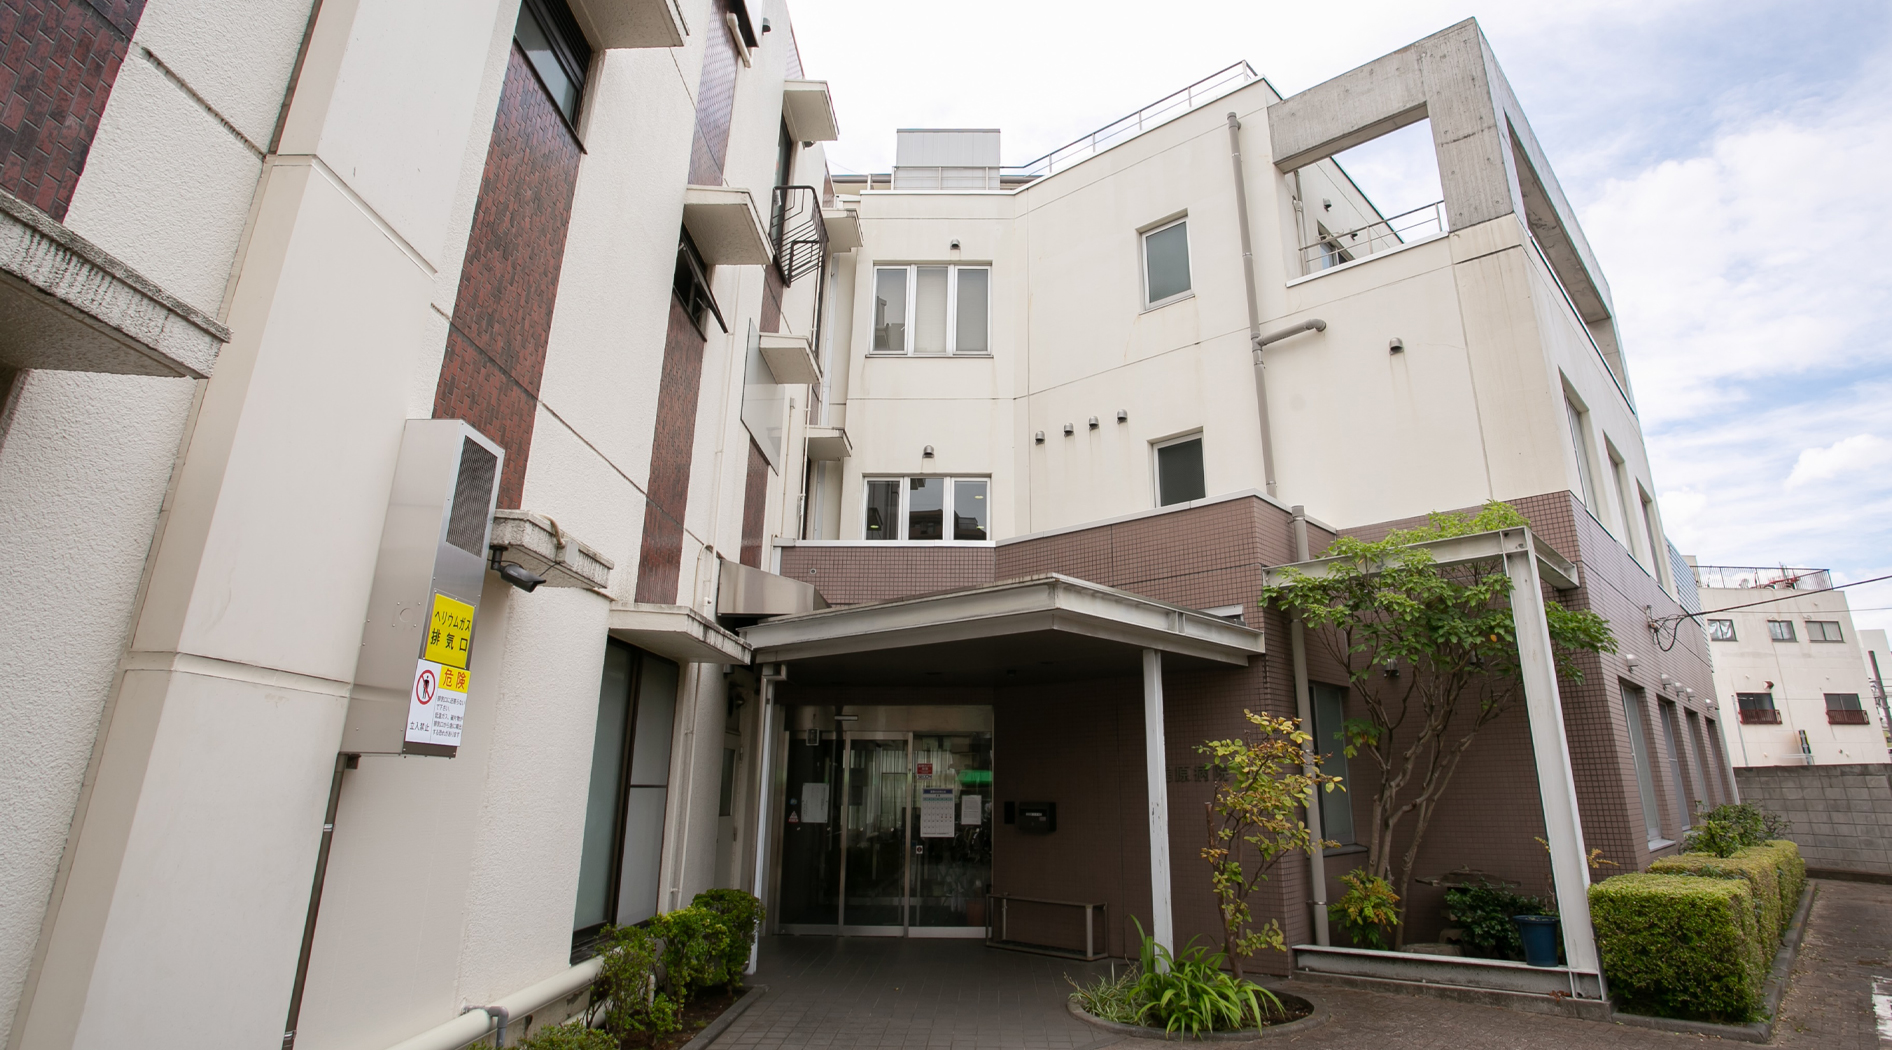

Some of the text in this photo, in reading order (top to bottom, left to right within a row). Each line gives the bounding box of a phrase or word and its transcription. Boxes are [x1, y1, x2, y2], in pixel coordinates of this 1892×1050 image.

[434, 611, 471, 631] ヘリウムガス
[430, 628, 468, 652] 排気口
[442, 668, 466, 690] 危険
[409, 721, 429, 732] 立入禁止
